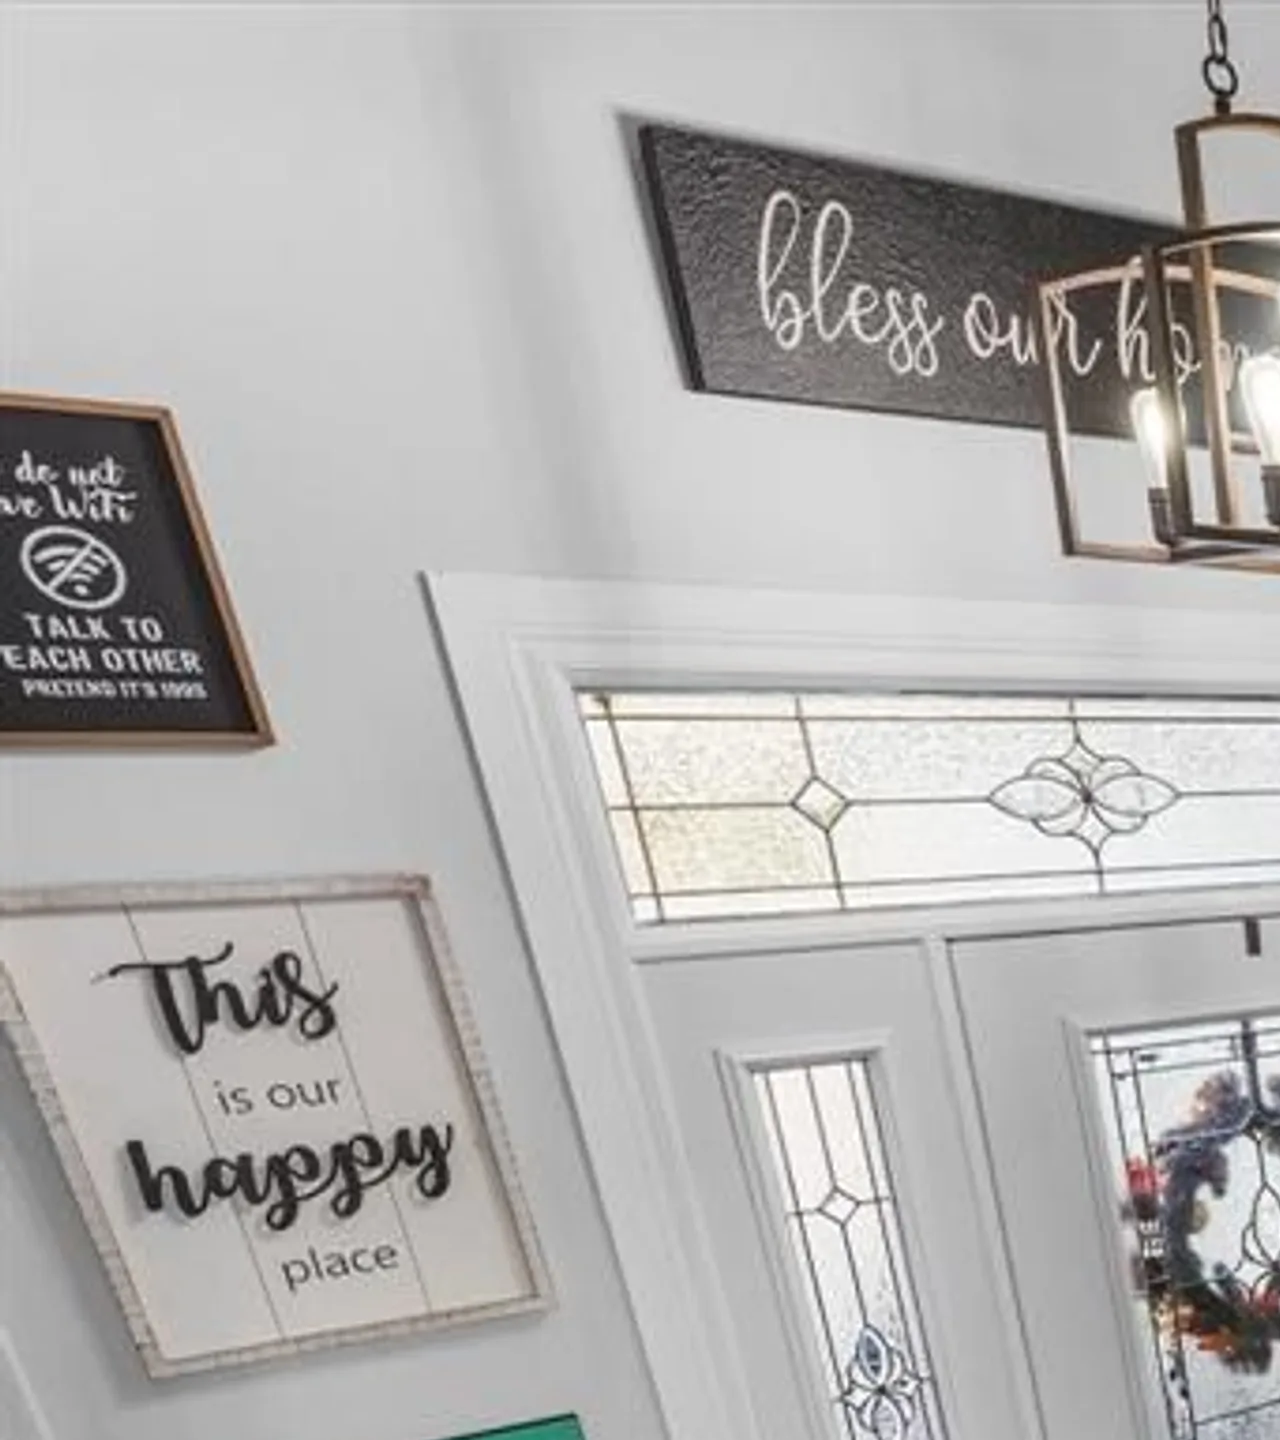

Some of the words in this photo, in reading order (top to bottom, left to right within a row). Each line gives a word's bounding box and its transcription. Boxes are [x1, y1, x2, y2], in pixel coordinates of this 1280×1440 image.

[757, 190, 945, 377] bless
[964, 286, 1102, 377] our
[14, 449, 60, 485] do
[67, 455, 126, 487] not
[23, 611, 111, 640] TALK
[120, 616, 163, 643] TO
[0, 643, 92, 672] EACH
[101, 647, 204, 675] OTHER
[107, 940, 339, 1055] This
[213, 1078, 254, 1117] is
[265, 1076, 342, 1110] our
[125, 1121, 455, 1232] happy
[281, 1239, 400, 1293] place
